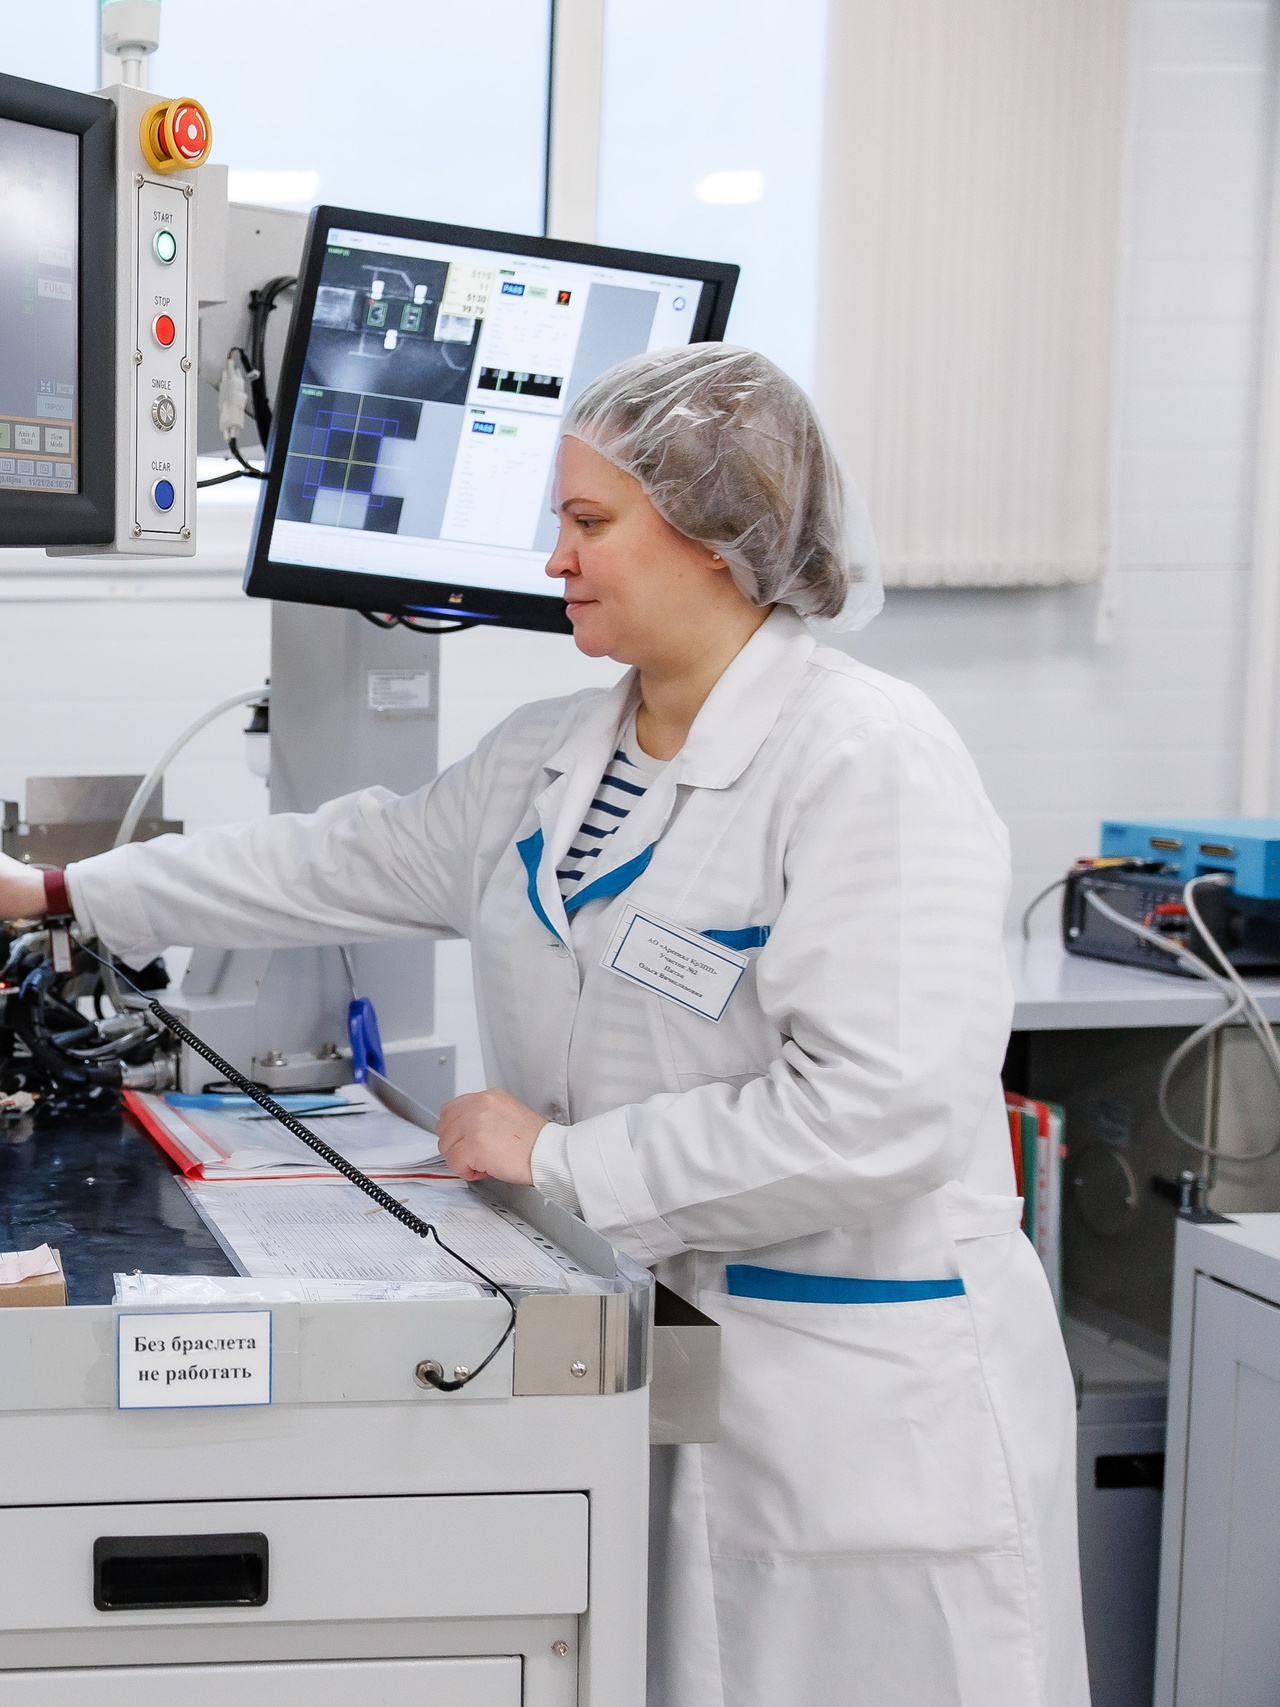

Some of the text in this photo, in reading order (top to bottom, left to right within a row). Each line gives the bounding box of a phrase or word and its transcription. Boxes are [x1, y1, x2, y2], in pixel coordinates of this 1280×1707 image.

[153, 210, 173, 224] START
[44, 282, 65, 294] FULL
[154, 295, 171, 307] STOP
[151, 378, 172, 390] SINGLE
[45, 403, 64, 411] TRIPOD
[151, 461, 171, 473] CLEAR
[648, 937, 659, 946] АО
[638, 962, 658, 976] Ольга
[660, 952, 698, 976] Участок №2
[134, 1335, 256, 1355] Без браслета
[138, 1364, 252, 1385] не работать
